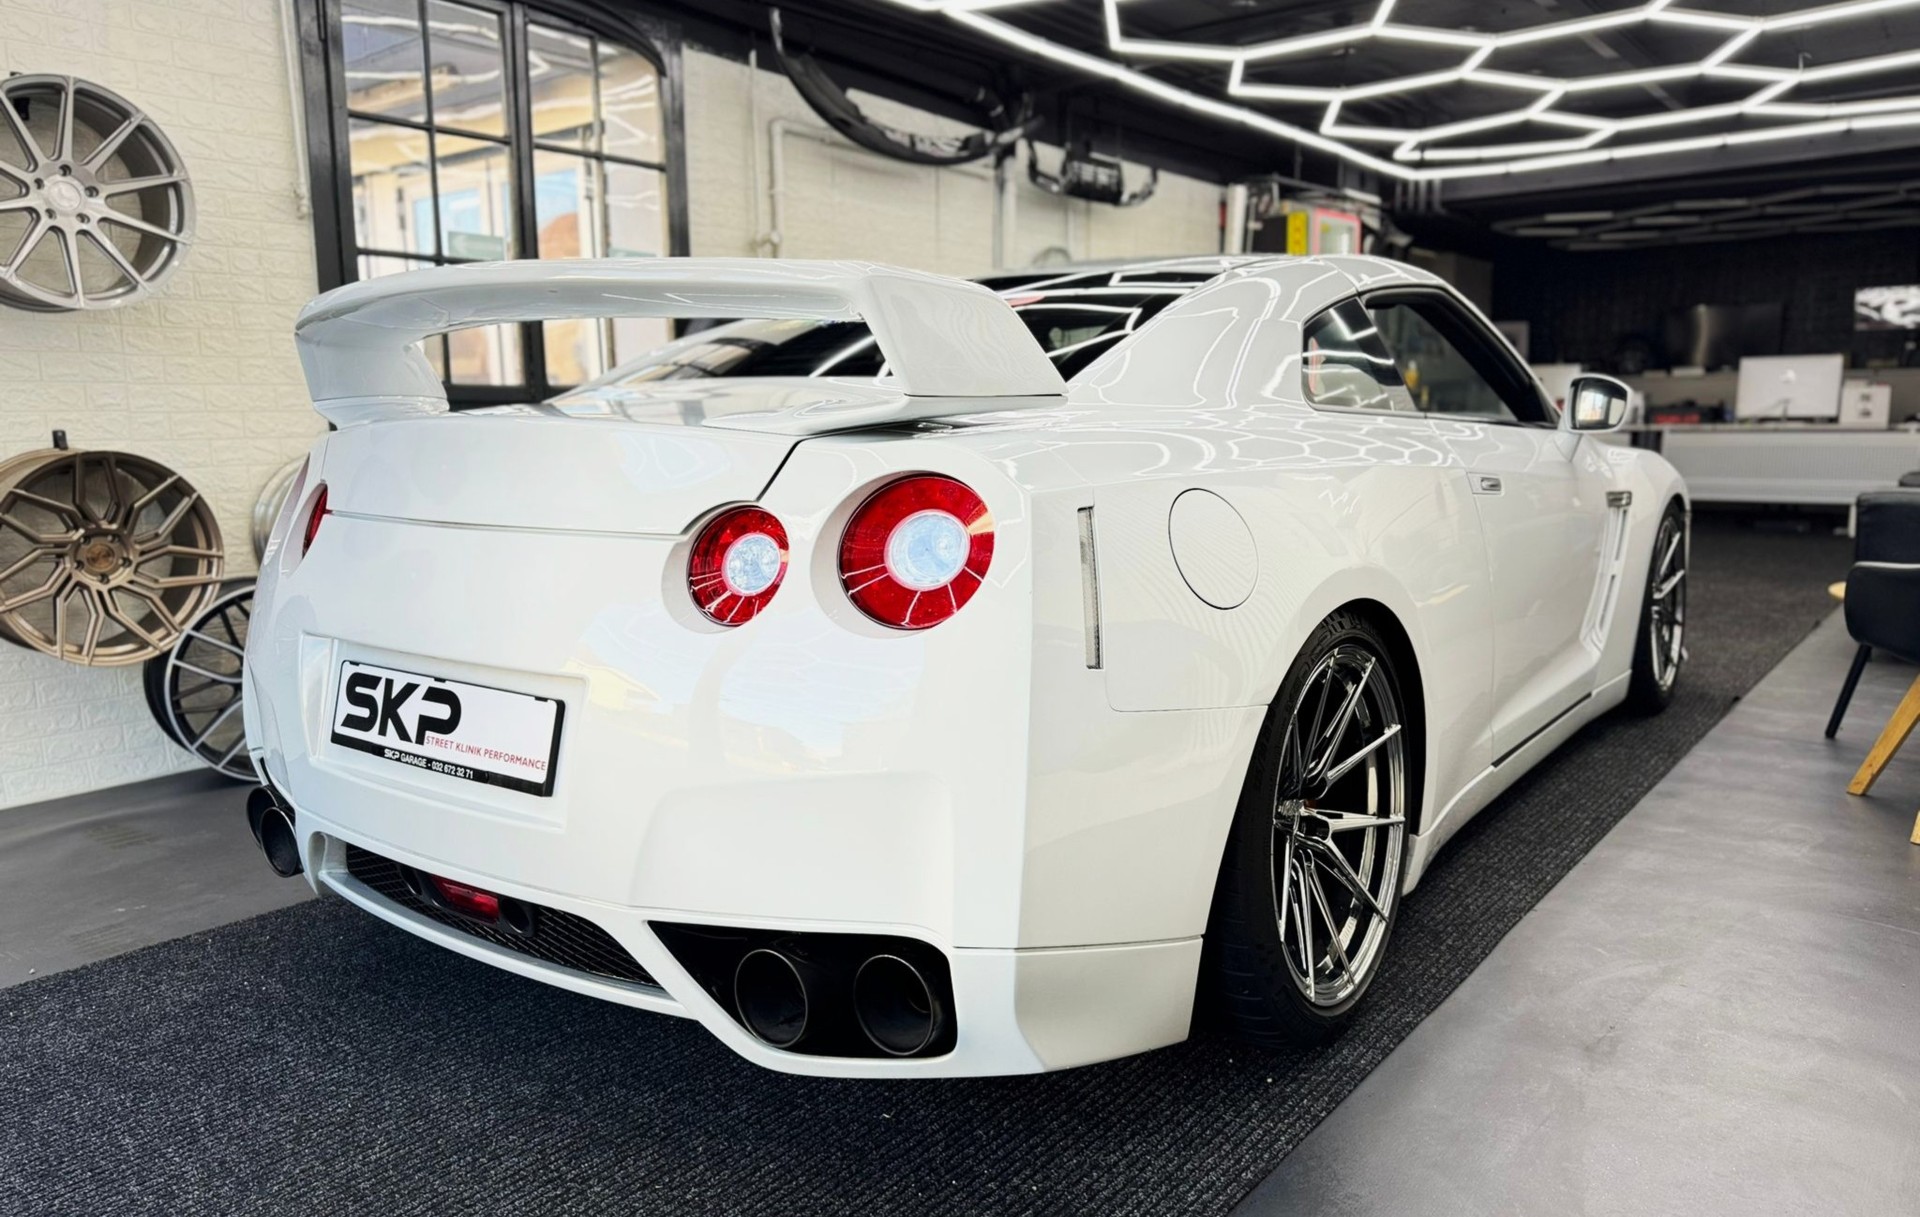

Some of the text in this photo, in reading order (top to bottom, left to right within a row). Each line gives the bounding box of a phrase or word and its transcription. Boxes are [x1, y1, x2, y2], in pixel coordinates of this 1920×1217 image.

[341, 672, 462, 745] SKP
[384, 748, 400, 760] SKP
[400, 753, 427, 768] GARAGE
[431, 761, 443, 772] 032
[444, 764, 456, 776] 672
[456, 767, 465, 777] 32
[465, 769, 474, 779] 71
[426, 735, 546, 771] STREET KLINIK PERFORMANCE
